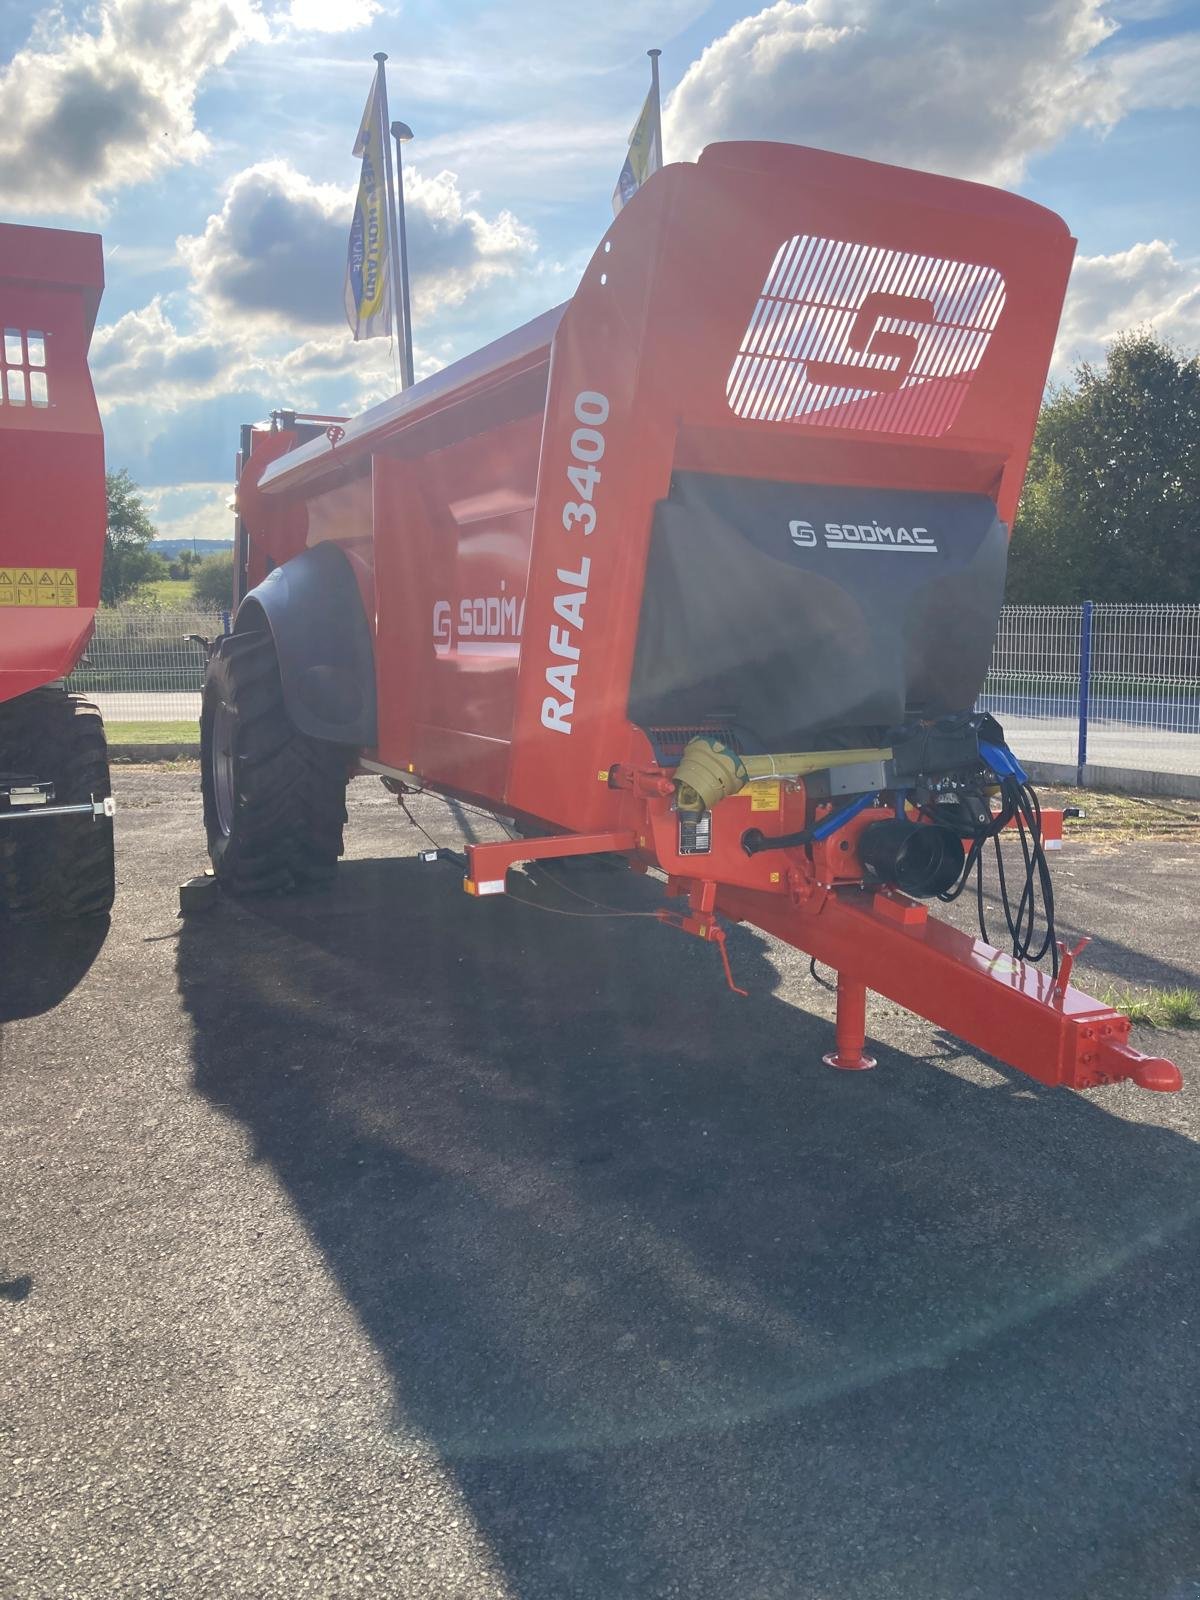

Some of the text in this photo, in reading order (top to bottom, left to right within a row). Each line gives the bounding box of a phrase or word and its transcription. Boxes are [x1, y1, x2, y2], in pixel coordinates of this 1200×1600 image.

[366, 207, 379, 300] HOLLAND
[541, 391, 609, 735] RAFAL 3400
